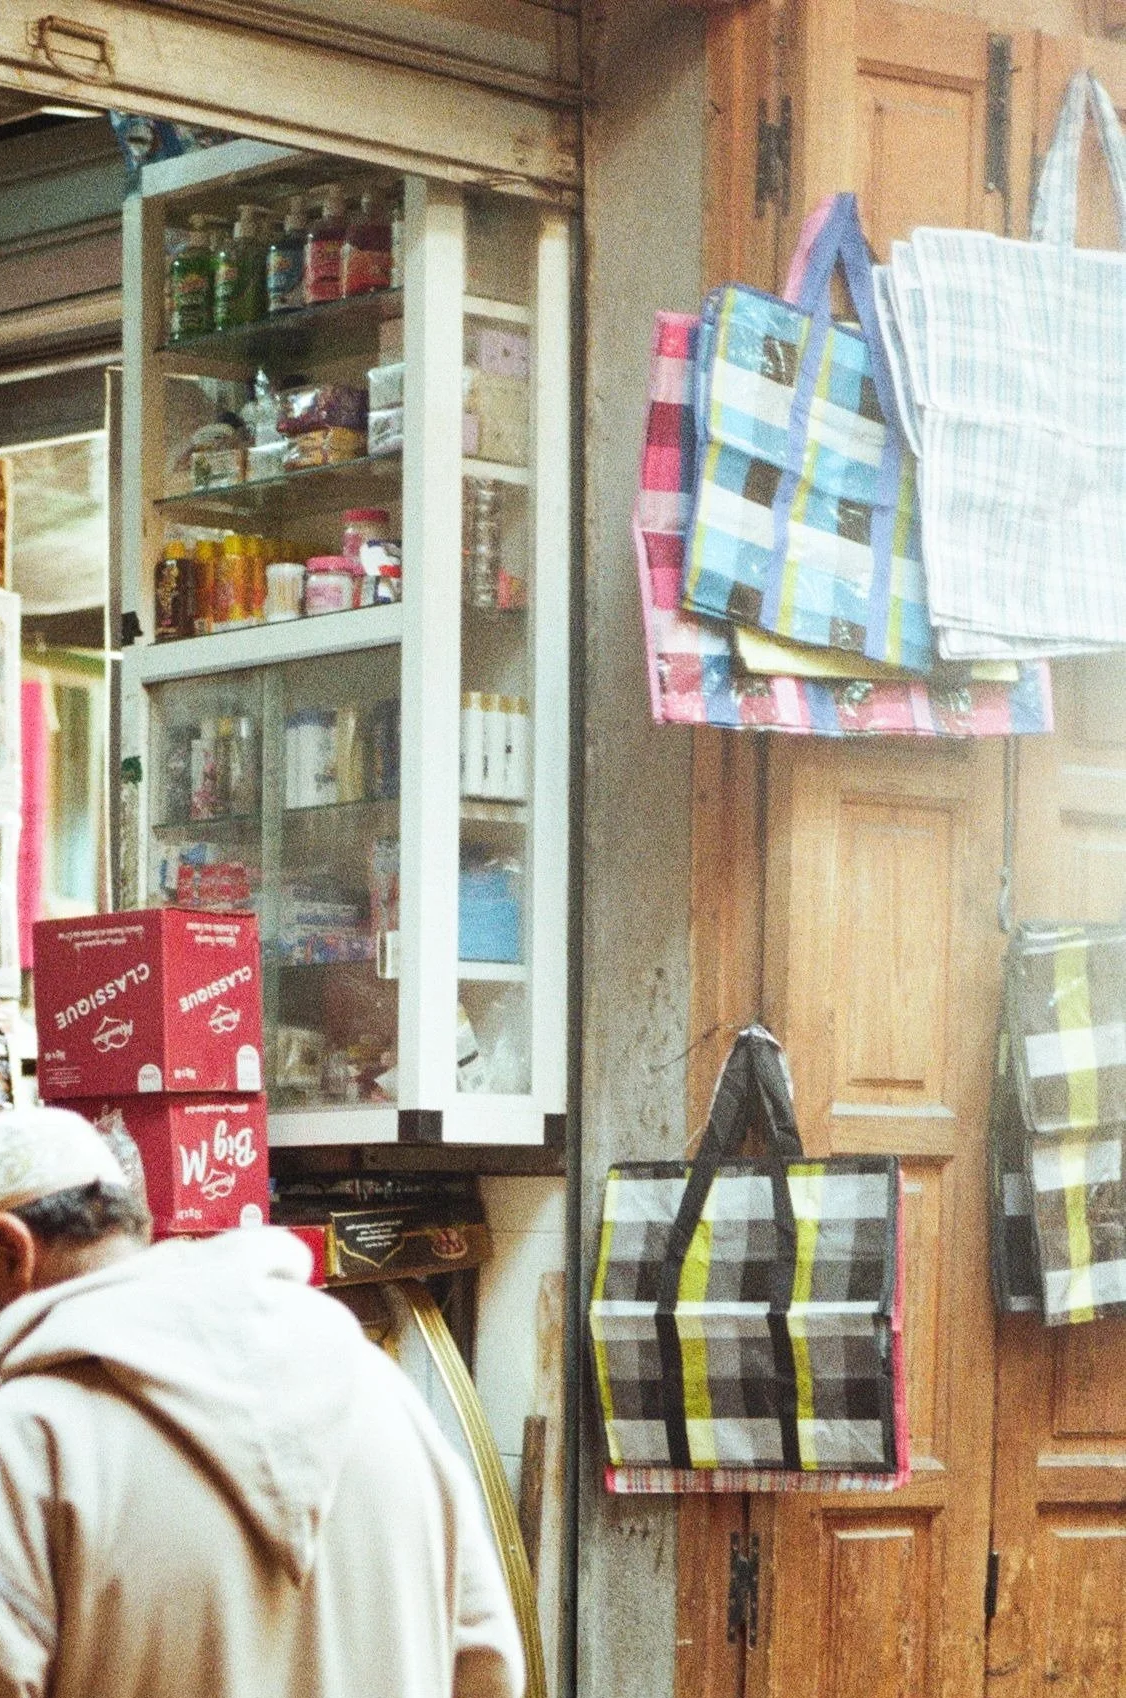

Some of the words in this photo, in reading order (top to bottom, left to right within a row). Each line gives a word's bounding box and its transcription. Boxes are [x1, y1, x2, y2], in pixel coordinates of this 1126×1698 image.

[55, 963, 151, 1030] CLASSIQUE
[179, 965, 253, 1013] CLASSIQUE
[178, 1140, 207, 1186] M
[213, 1119, 258, 1169] Big
